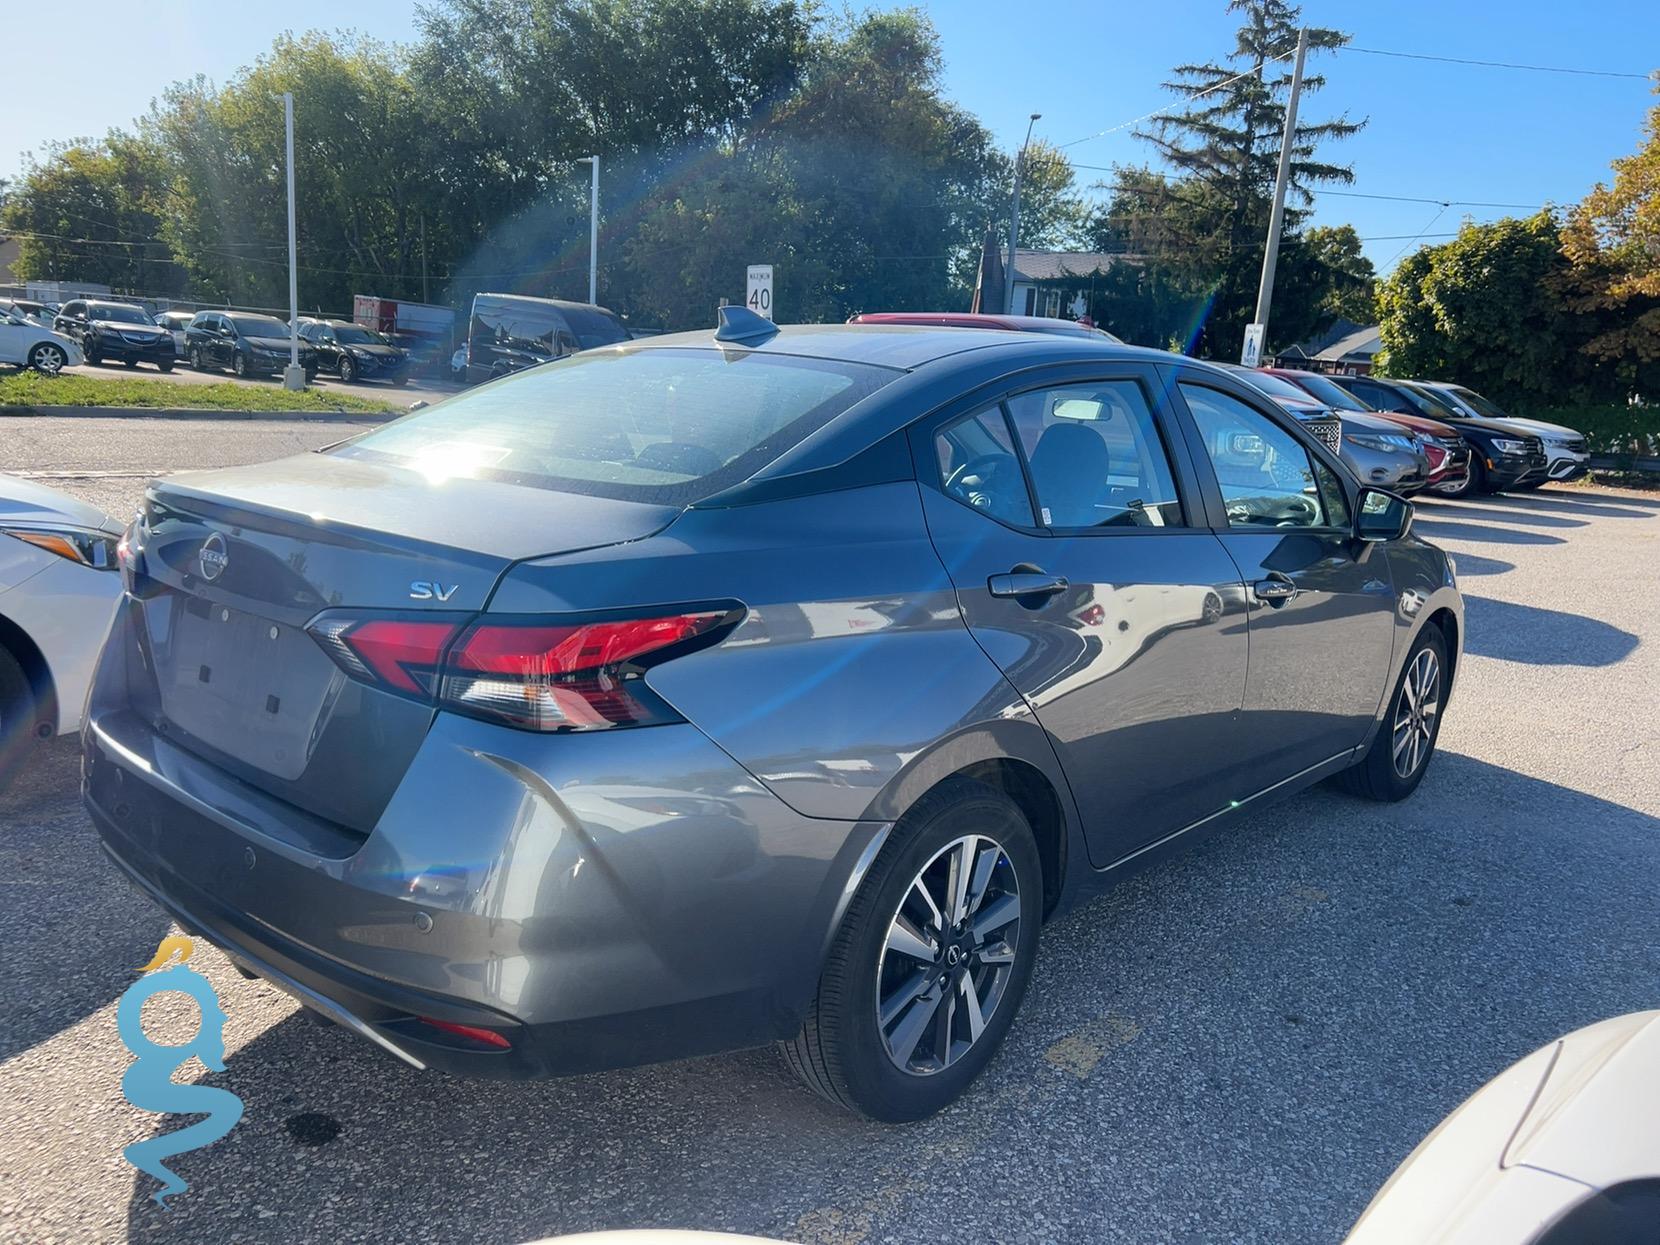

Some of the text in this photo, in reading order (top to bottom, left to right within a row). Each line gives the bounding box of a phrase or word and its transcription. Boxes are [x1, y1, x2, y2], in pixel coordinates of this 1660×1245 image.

[749, 288, 770, 310] 40
[200, 549, 228, 567] SSAN
[410, 581, 460, 601] SV
